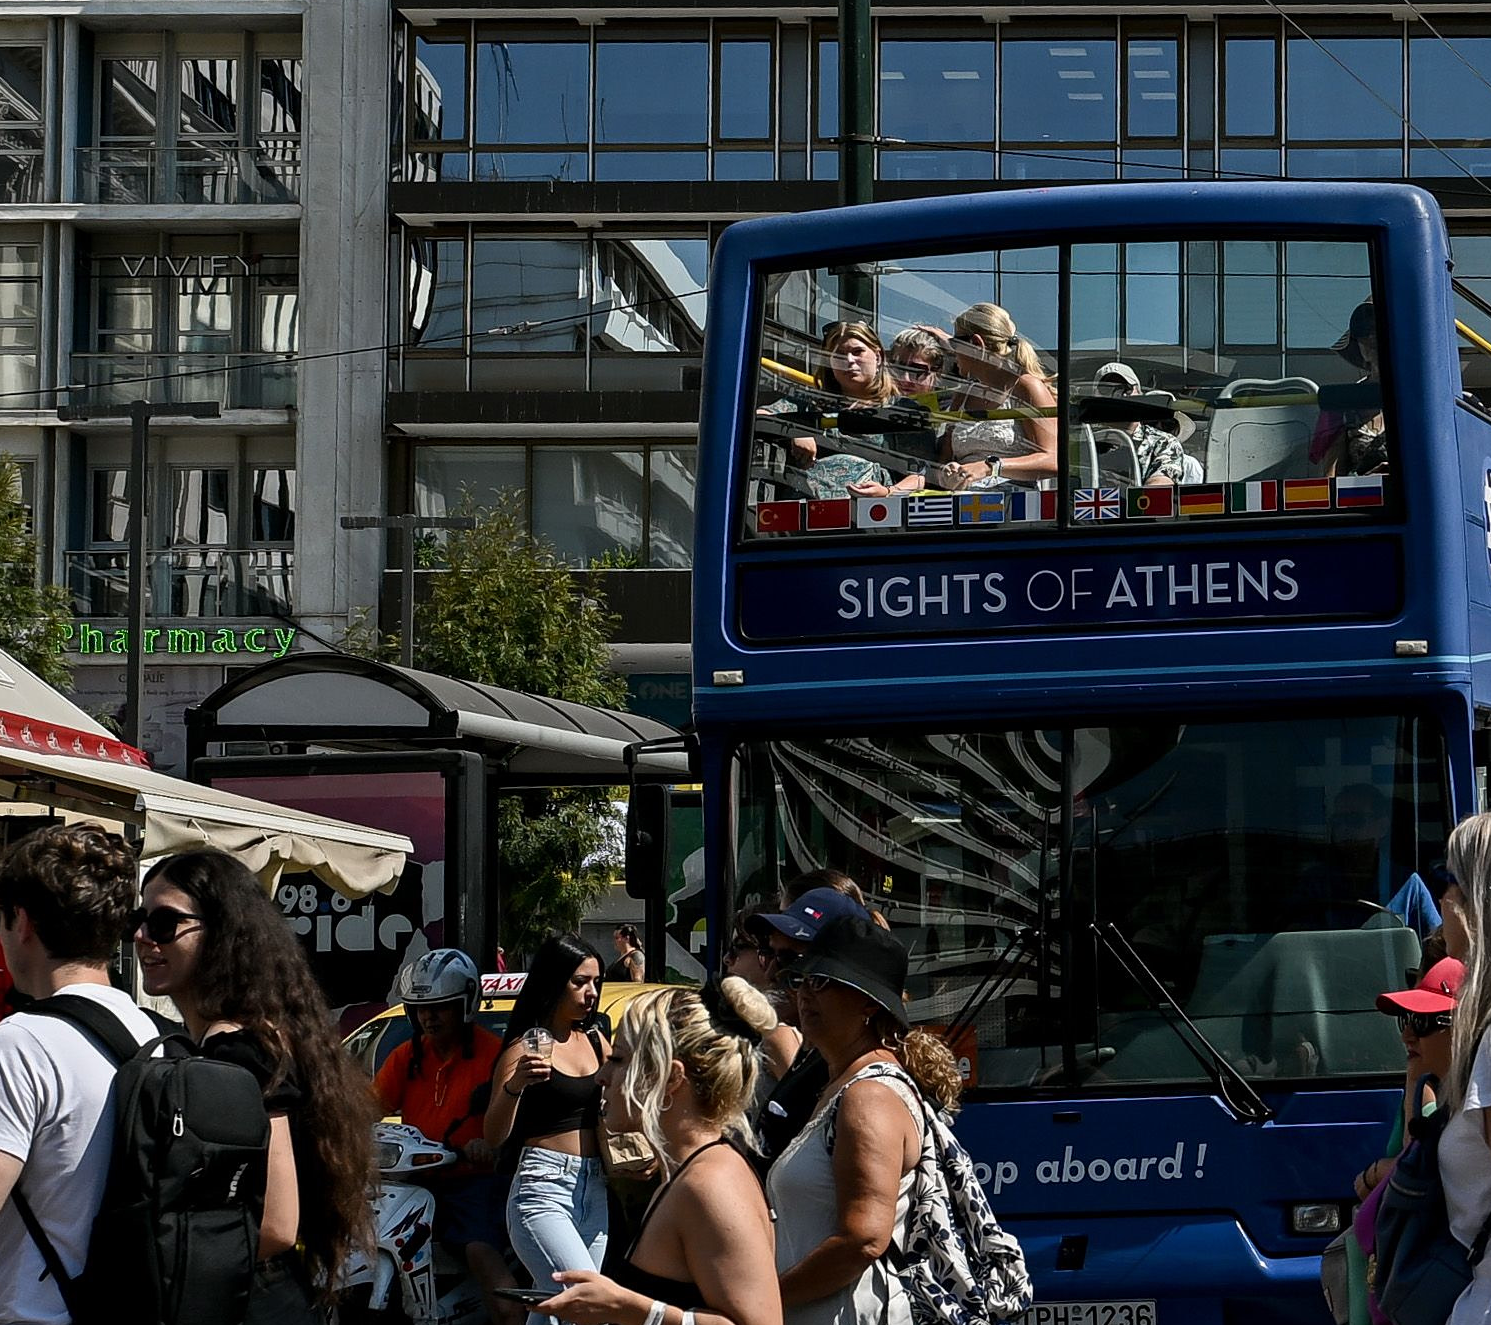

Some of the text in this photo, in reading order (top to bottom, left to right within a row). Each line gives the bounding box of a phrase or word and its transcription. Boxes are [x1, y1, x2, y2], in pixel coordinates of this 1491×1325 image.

[838, 558, 1301, 619] SIGHTS OF ATHENS
[55, 623, 296, 658] Pharmacy
[278, 884, 352, 914] 98.6
[480, 976, 525, 991] TAXI
